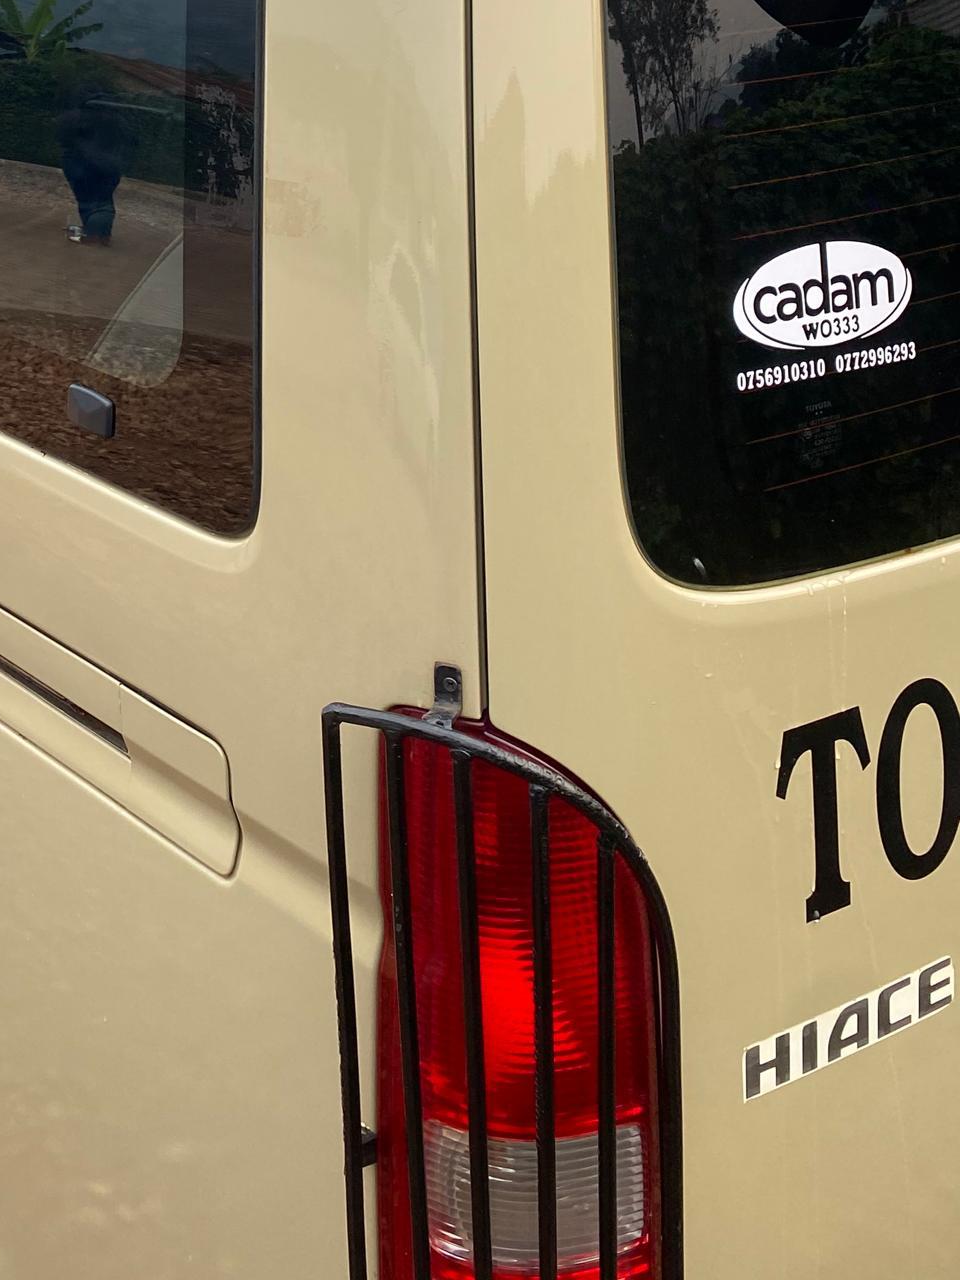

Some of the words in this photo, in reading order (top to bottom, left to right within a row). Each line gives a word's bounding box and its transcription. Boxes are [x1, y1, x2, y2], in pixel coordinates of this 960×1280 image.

[752, 242, 895, 324] cadam
[736, 358, 826, 392] 0756910310
[835, 341, 917, 372] 0772996293
[775, 677, 960, 924] TO
[745, 958, 953, 1100] HIACE
